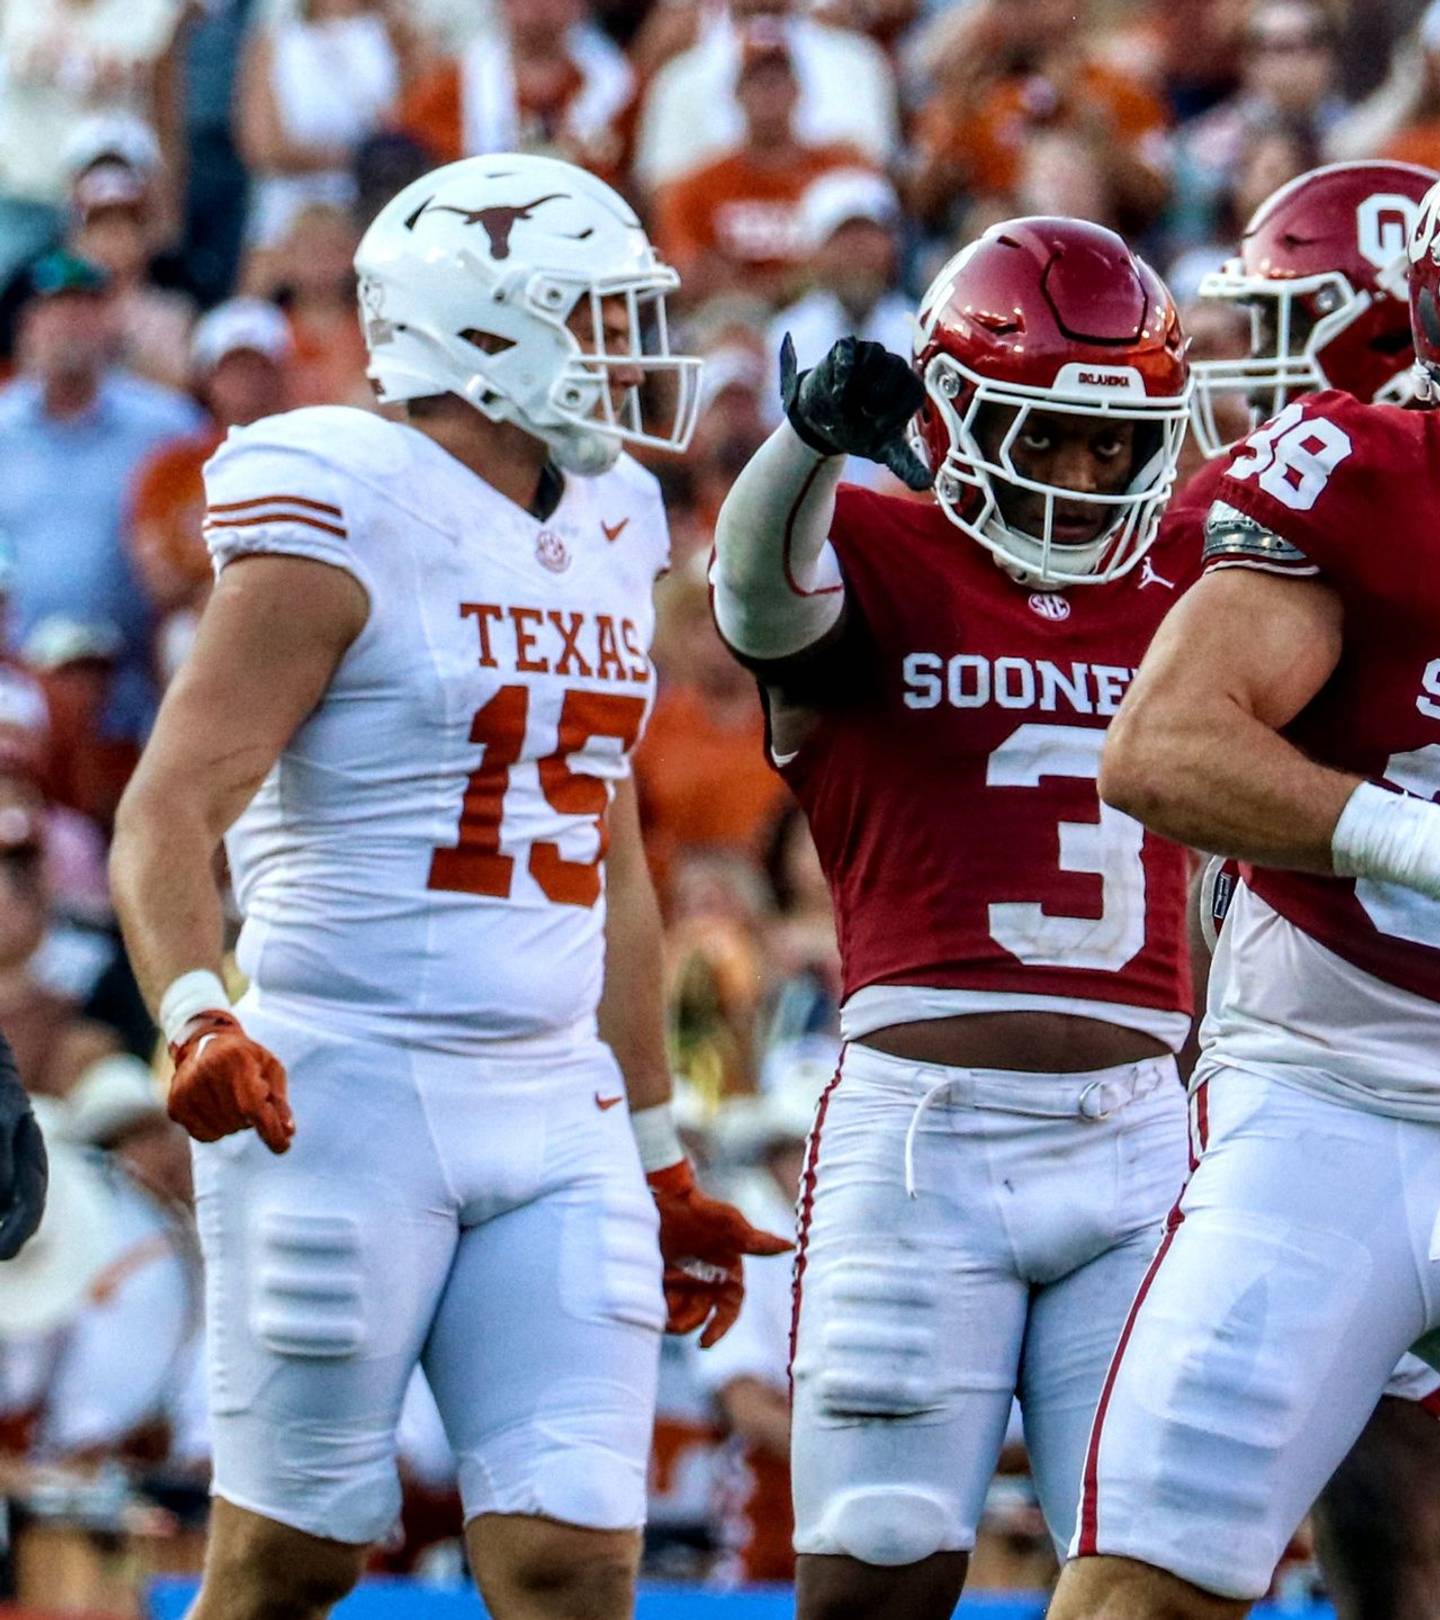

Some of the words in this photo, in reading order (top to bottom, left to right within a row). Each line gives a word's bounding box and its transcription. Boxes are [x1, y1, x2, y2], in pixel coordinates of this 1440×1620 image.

[1223, 403, 1353, 511] 38
[459, 602, 650, 683] TEXAS
[1030, 593, 1070, 620] SEC
[902, 651, 1138, 716] SOONE
[427, 685, 648, 909] 15
[986, 723, 1146, 973] 3
